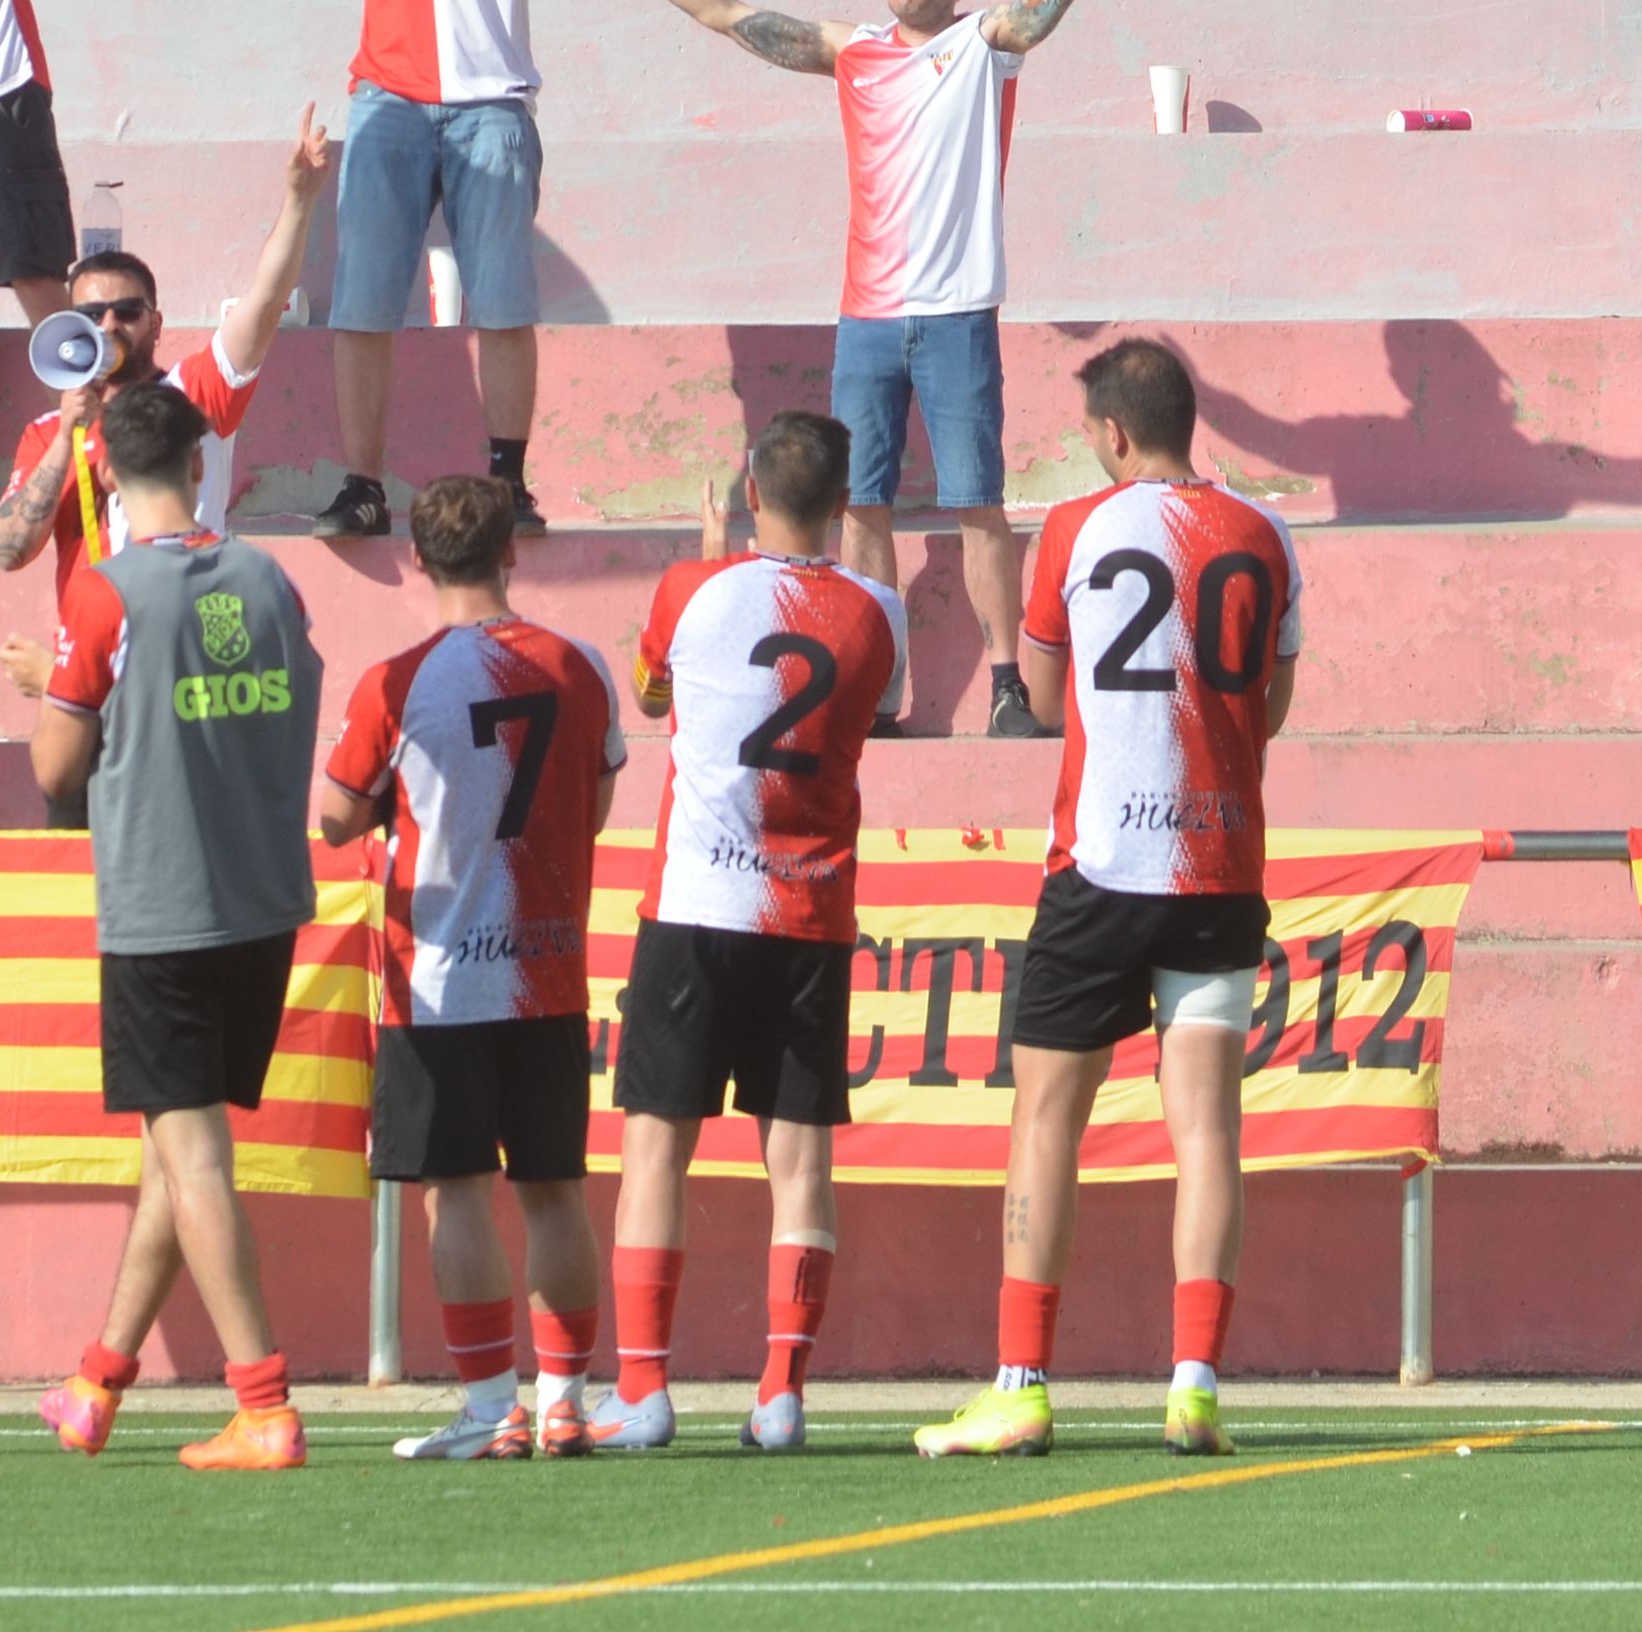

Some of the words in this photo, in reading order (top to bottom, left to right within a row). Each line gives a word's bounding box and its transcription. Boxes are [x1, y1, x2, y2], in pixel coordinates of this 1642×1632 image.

[173, 668, 293, 722] GIOS
[1088, 548, 1273, 696] 20
[468, 691, 558, 841] 7
[739, 632, 838, 777] 2
[1241, 919, 1427, 1079] 912
